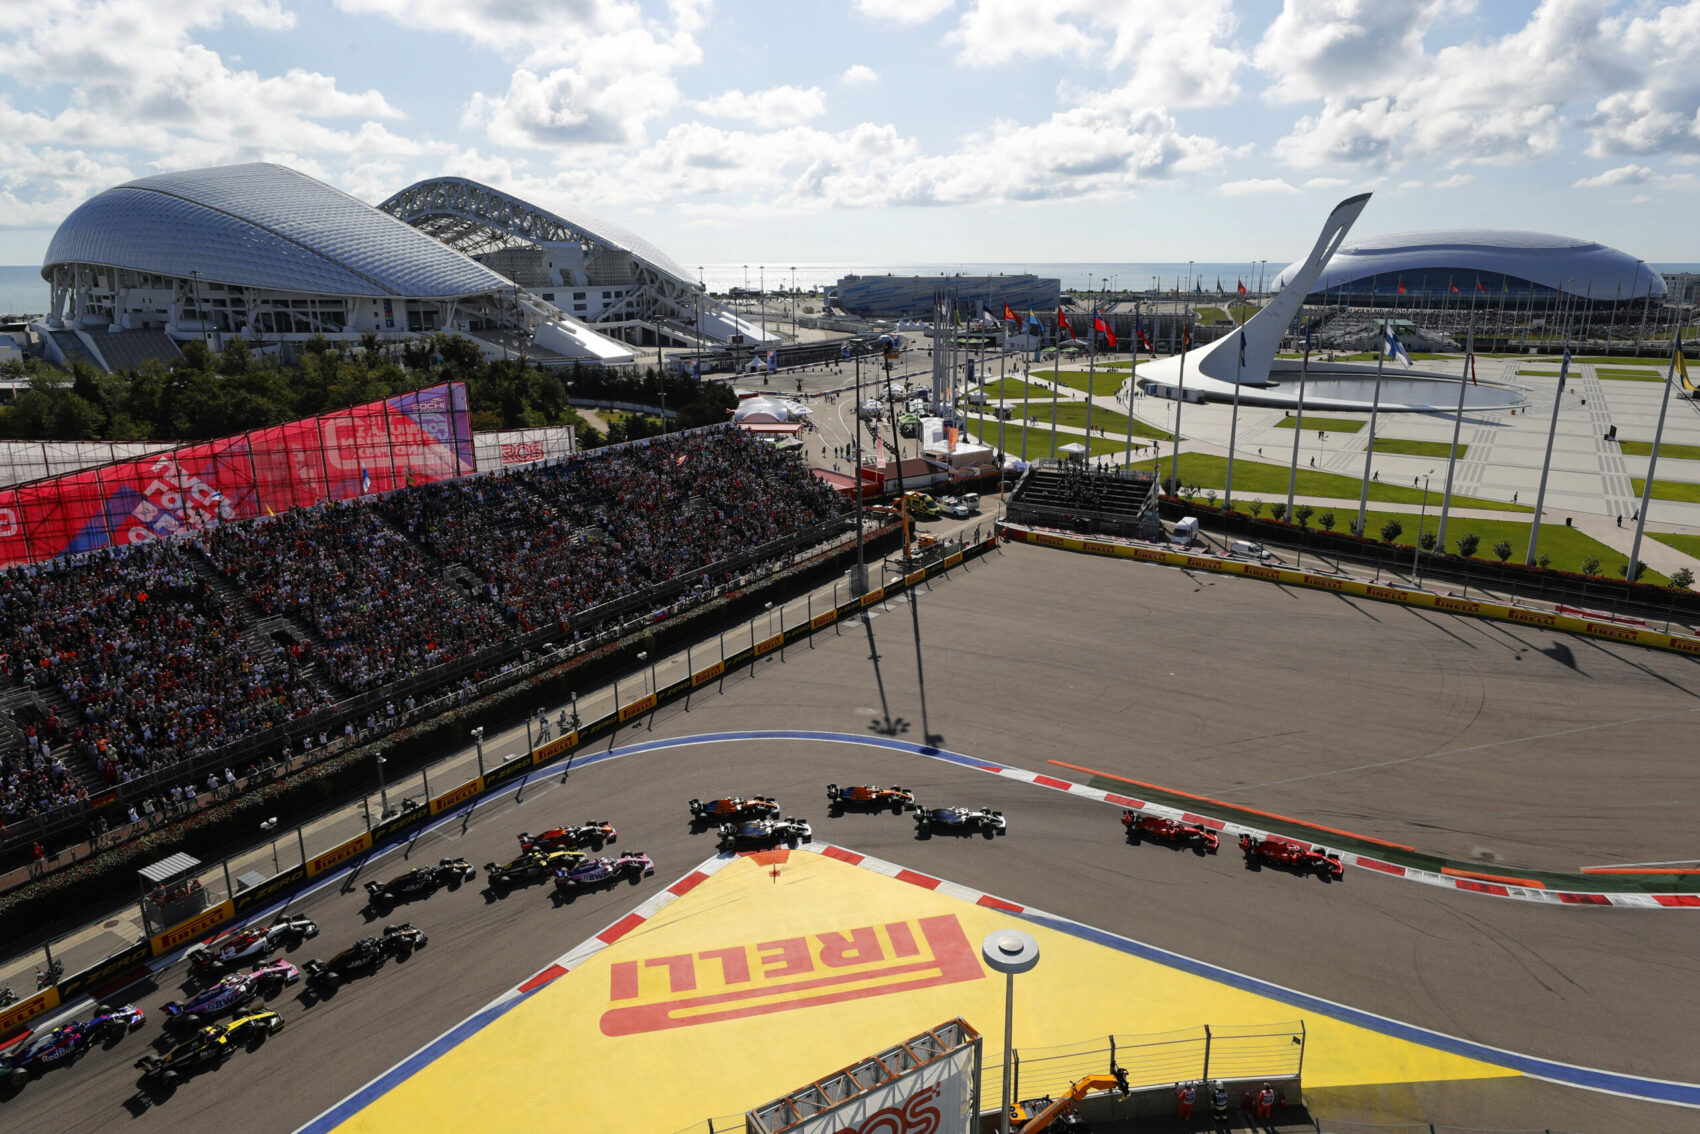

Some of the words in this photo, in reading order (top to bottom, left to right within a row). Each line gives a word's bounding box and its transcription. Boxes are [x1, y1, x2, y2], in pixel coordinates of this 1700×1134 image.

[411, 402, 444, 410] SOCHI
[1083, 542, 1115, 554] PIRELLI
[1134, 549, 1166, 561] PIRELLI
[1187, 557, 1222, 570] PIRELLI
[1244, 565, 1280, 579] PIRELLI
[1304, 575, 1342, 590] PIRELLI
[1367, 586, 1408, 601] PIRELLI
[1435, 598, 1480, 612] PIRELLI
[1508, 609, 1556, 626] PIRELLI
[1587, 622, 1639, 640] PIRELLI
[696, 665, 721, 683] PIRELLI
[624, 697, 652, 718] PIRELLI
[538, 736, 574, 760] PIRELLI
[437, 782, 478, 810] PIRELLI
[314, 838, 364, 872] PIRELLI
[160, 908, 225, 948] PIRELLI
[64, 981, 81, 996] P
[87, 948, 149, 984] ZERO
[600, 913, 986, 1037] PIRELLI
